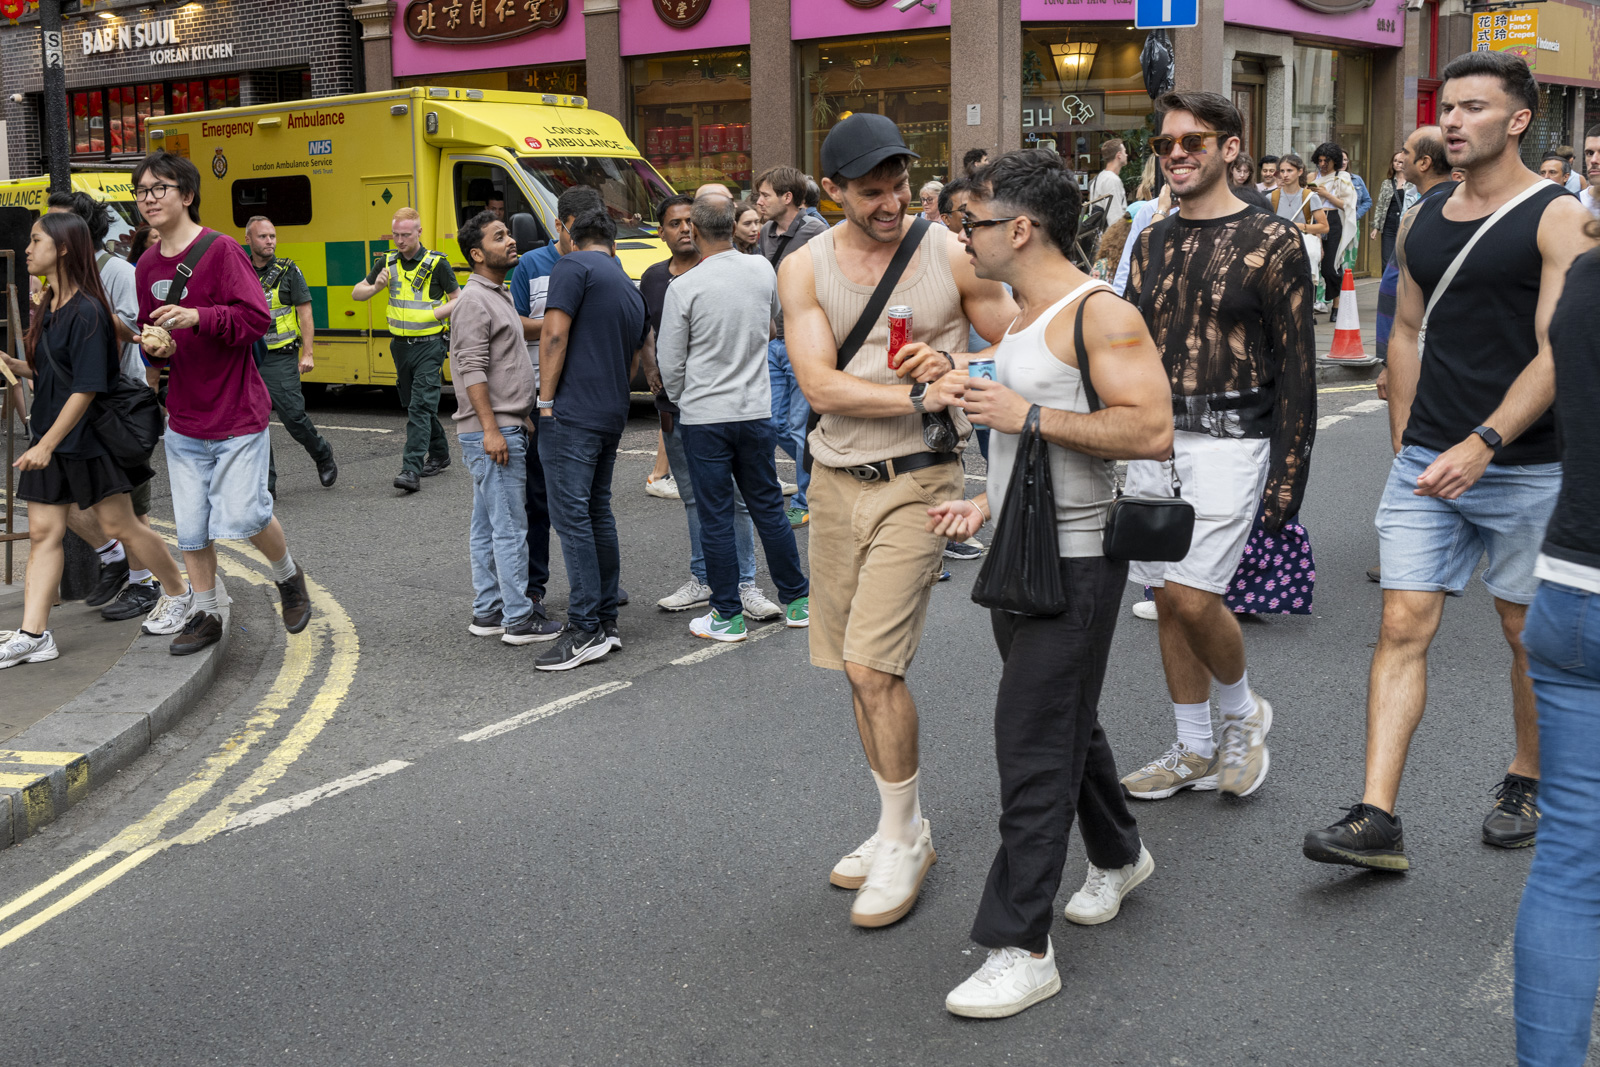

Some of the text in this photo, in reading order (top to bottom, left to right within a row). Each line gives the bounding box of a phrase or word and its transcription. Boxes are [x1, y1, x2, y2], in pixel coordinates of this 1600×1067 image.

[1509, 14, 1531, 22] Ling's
[1494, 14, 1507, 40] 玲玲
[82, 19, 180, 55] BAB N SUUL
[1508, 31, 1535, 39] Crepes
[150, 43, 233, 65] KOREAN KITCHEN
[202, 111, 345, 138] Emergency Ambulance
[543, 126, 599, 136] LONDON
[309, 141, 332, 155] NHS
[545, 138, 624, 150] AMBULANCE
[252, 157, 332, 171] London Ambulance Service
